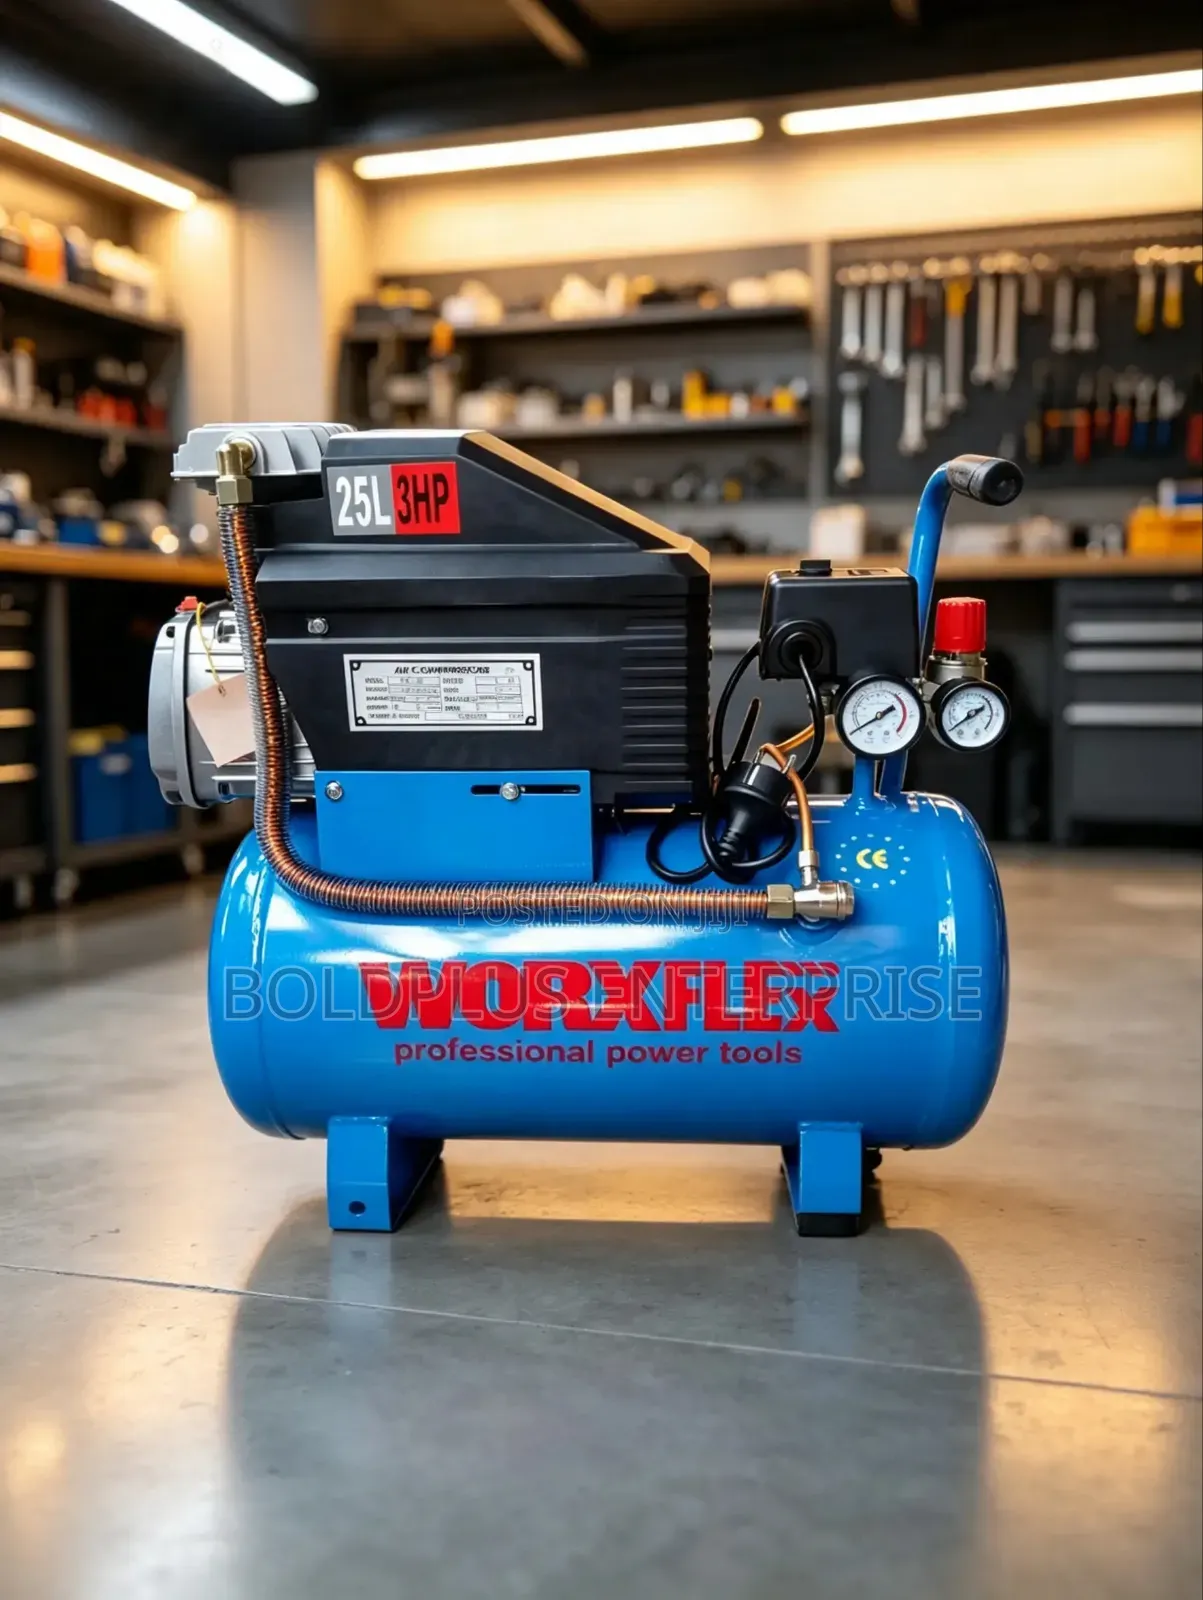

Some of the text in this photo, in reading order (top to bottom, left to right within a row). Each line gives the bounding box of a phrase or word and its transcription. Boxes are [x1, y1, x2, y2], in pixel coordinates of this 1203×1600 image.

[335, 472, 449, 527] 25L 3HP
[856, 847, 889, 870] CE
[394, 1036, 802, 1069] professional power tools
